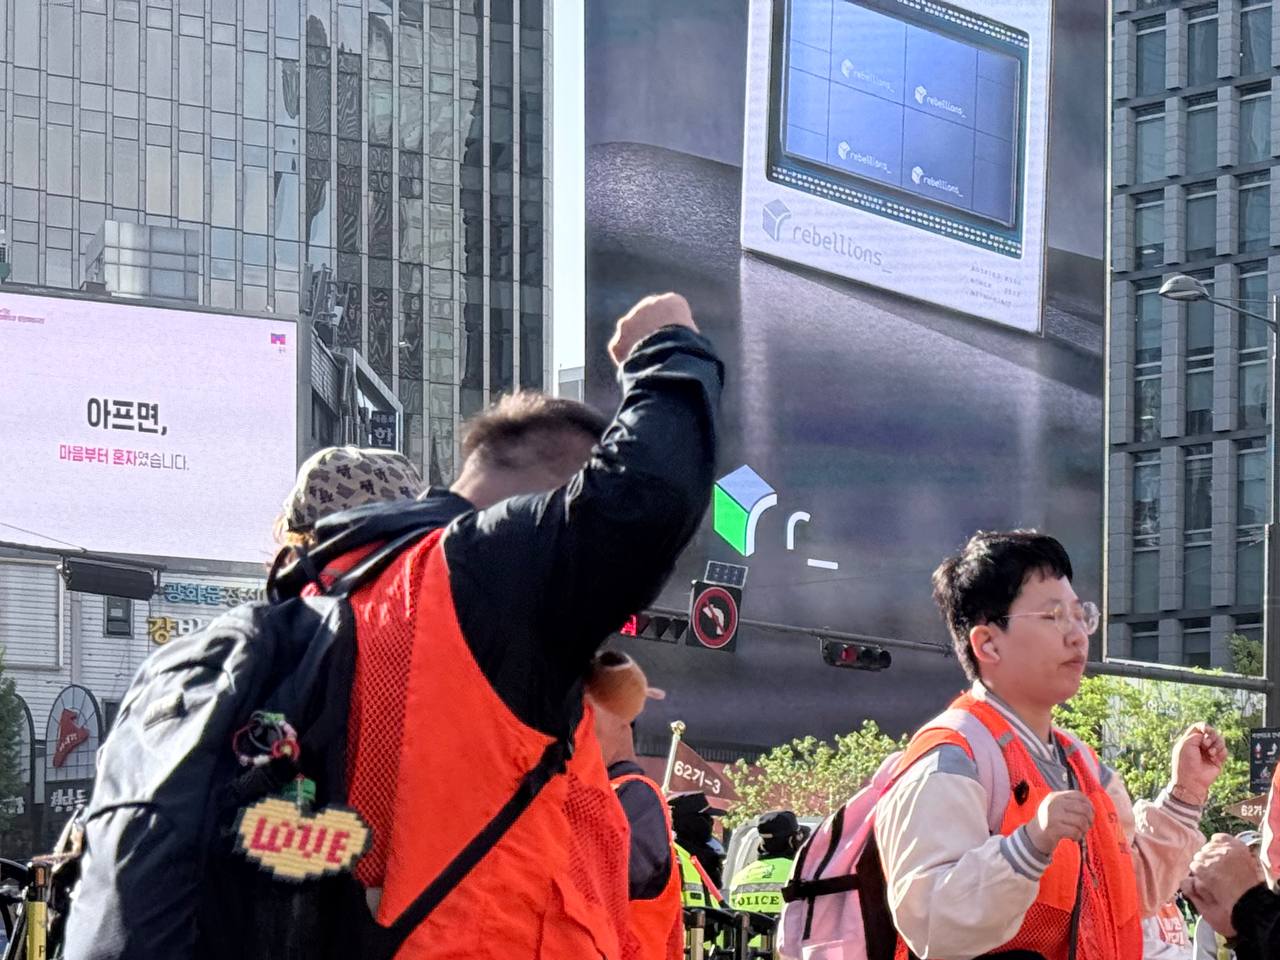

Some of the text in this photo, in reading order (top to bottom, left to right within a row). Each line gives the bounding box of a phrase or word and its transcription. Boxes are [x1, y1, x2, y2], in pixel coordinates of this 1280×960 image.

[87, 397, 168, 436] 아프면,
[59, 444, 190, 471] 마음부터 혼자였습니다.
[673, 759, 722, 795] 6271-3
[249, 815, 351, 864] LOVE
